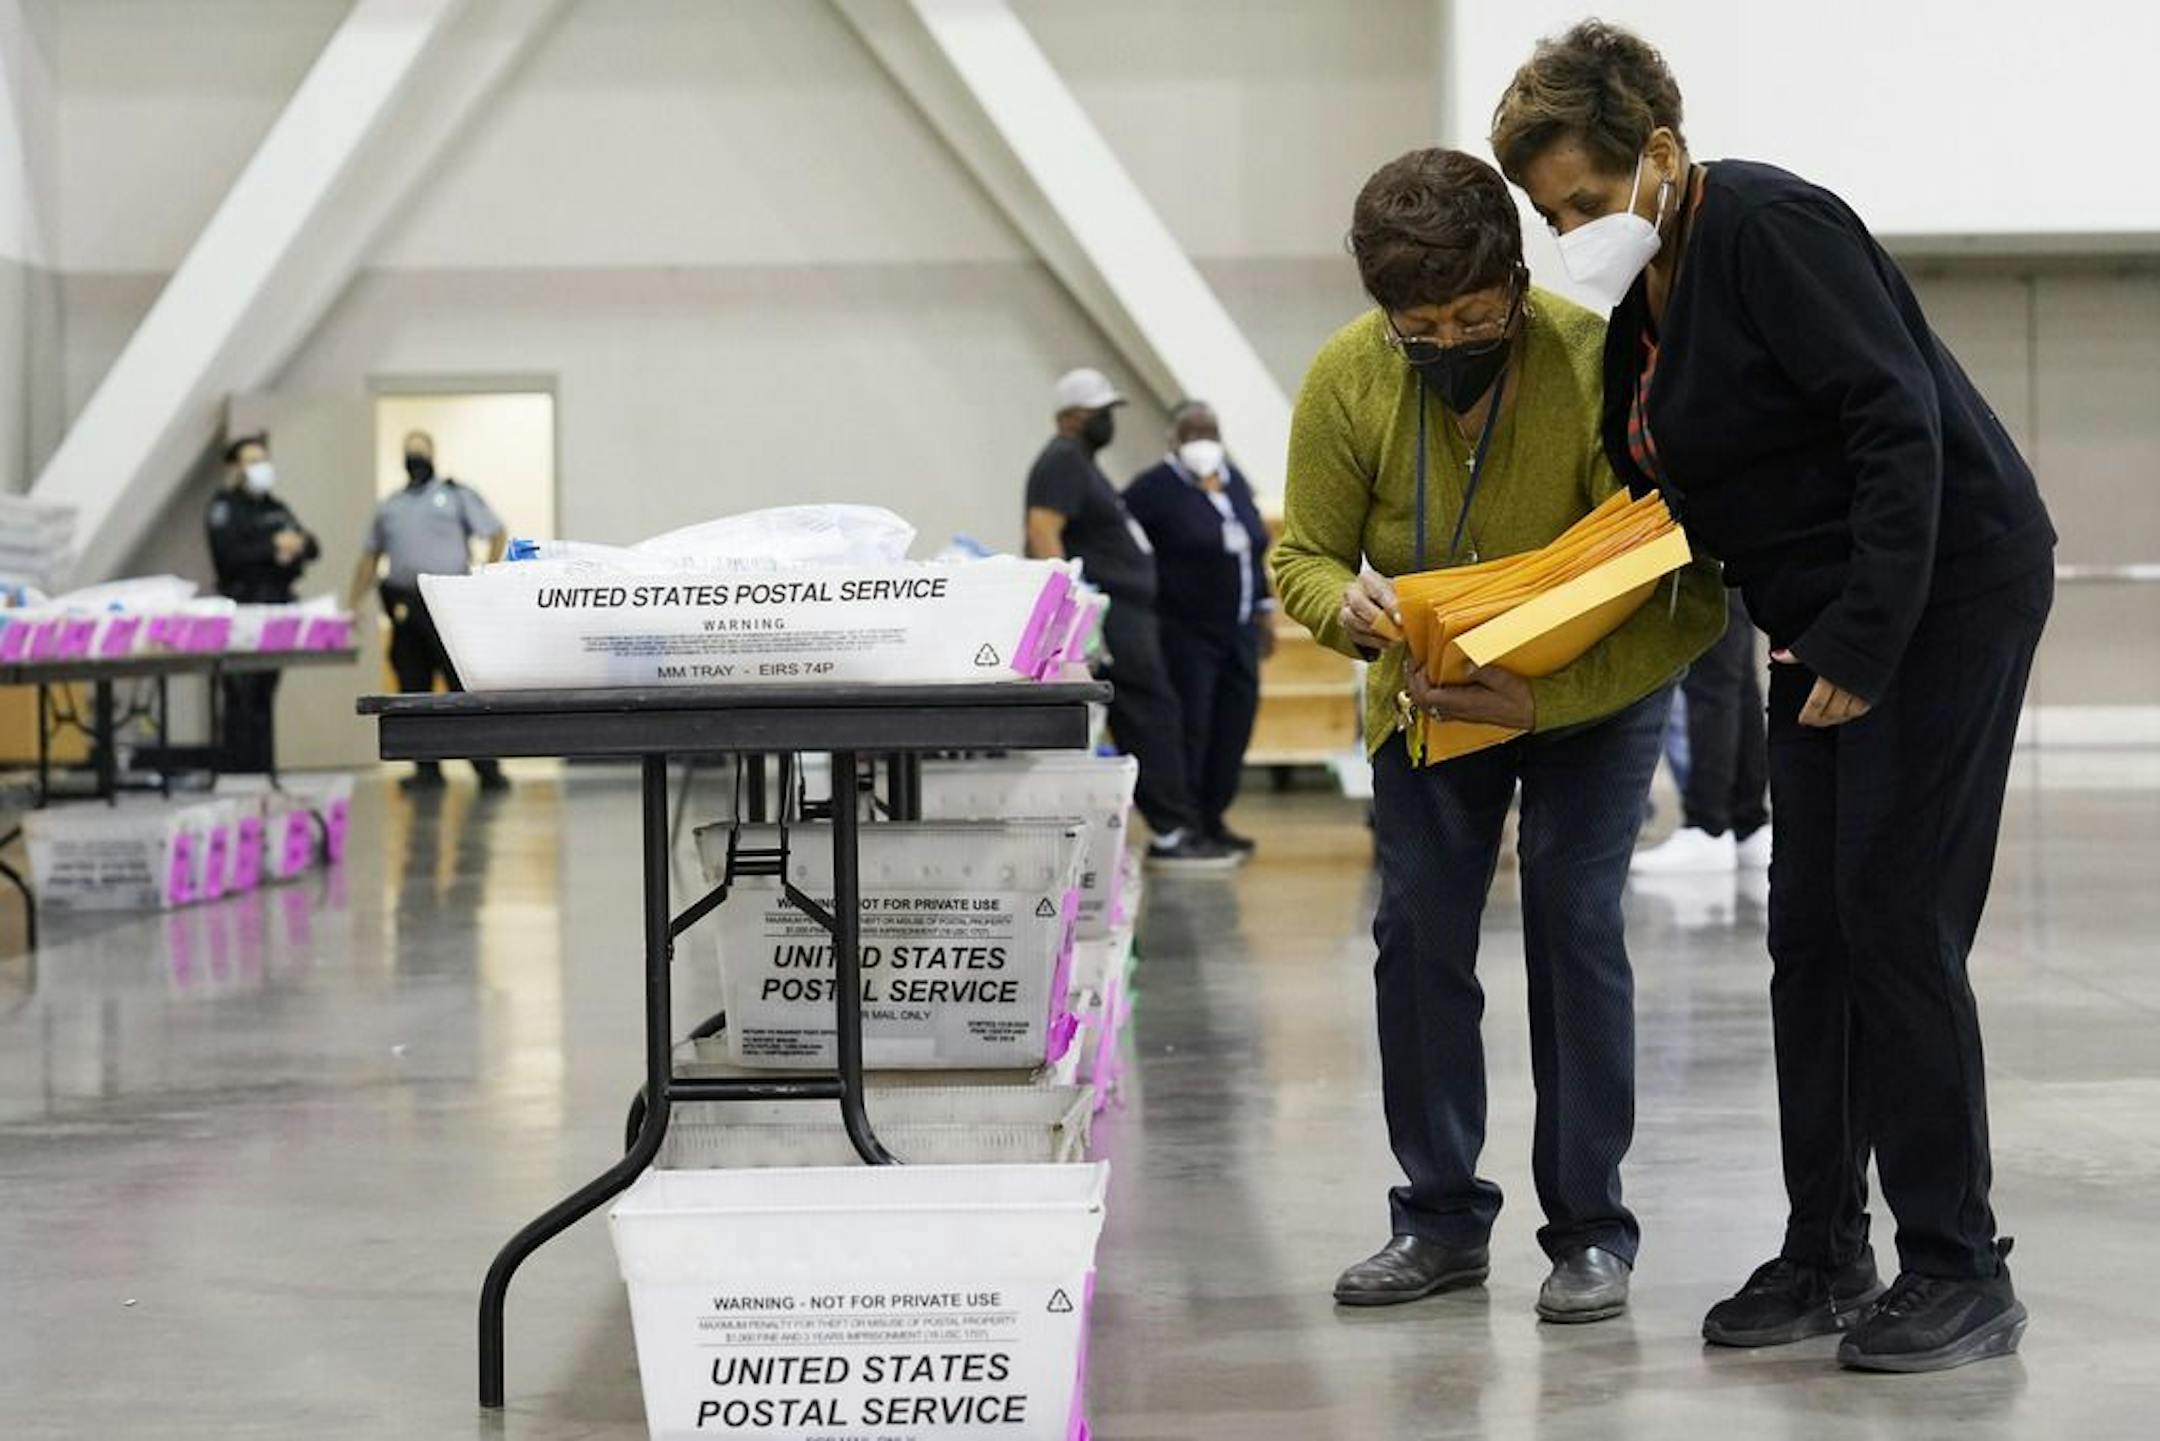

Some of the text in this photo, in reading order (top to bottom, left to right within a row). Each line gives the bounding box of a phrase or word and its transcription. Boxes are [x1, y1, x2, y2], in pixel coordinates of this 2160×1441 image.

[537, 578, 949, 608] UNITED STATES POSTAL SERVICE
[703, 618, 785, 632] WARNING
[657, 665, 687, 679] MM
[691, 664, 735, 678] TRAY
[759, 662, 801, 676] EIRS
[804, 661, 835, 675] 74P
[859, 898, 1000, 911] OT FOR PRIVATE USE
[773, 945, 1007, 969] UNITD STATES
[761, 978, 1019, 1002] POSTL SERVICE
[872, 1011, 898, 1020] MAIL
[901, 1010, 932, 1021] ONLY
[713, 1296, 795, 1311] WARNING
[811, 1295, 845, 1310] NOT
[851, 1295, 886, 1309] FOR
[892, 1293, 962, 1308] PRIVATE
[967, 1292, 1002, 1307] USE
[711, 1353, 1011, 1386] UNITED STATES
[696, 1395, 1028, 1428] POSTAL SERVICE
